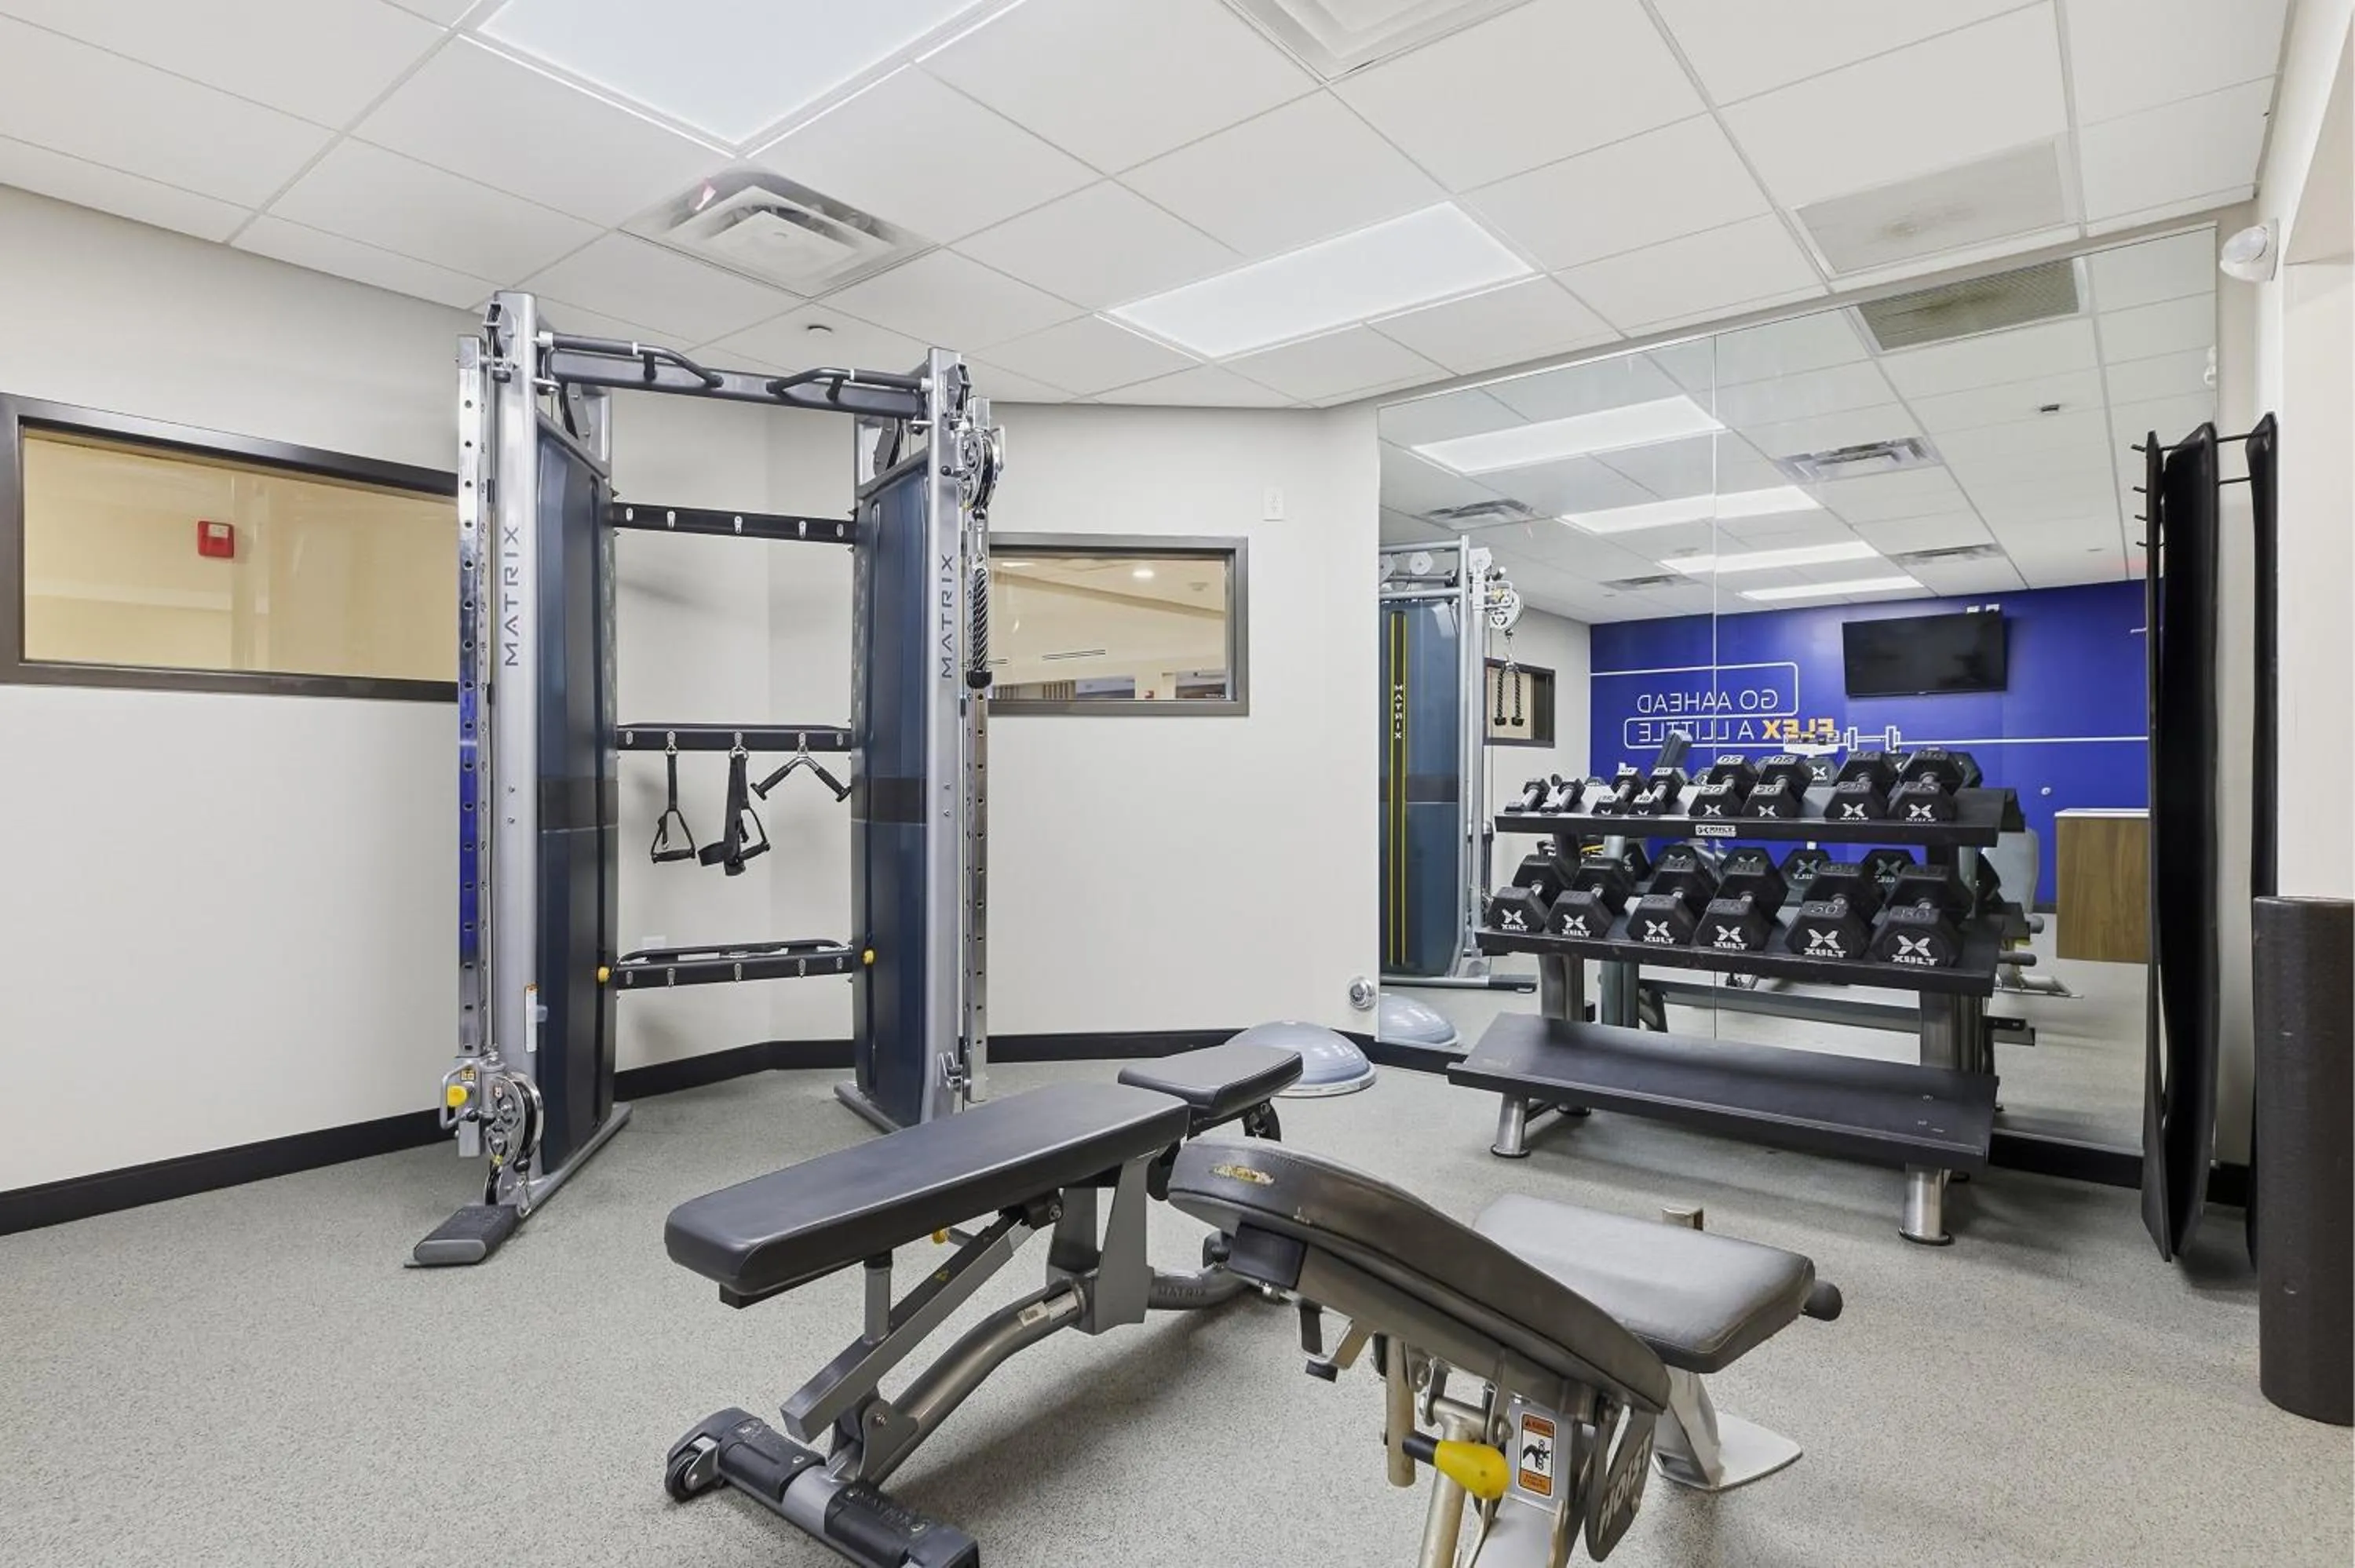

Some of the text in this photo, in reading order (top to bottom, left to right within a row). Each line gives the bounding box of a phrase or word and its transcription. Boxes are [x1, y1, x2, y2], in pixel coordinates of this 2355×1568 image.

[503, 526, 520, 666] MATRIX
[941, 554, 953, 679] MATRIX
[1804, 947, 1846, 957] XULT
[1892, 954, 1938, 966] XULT
